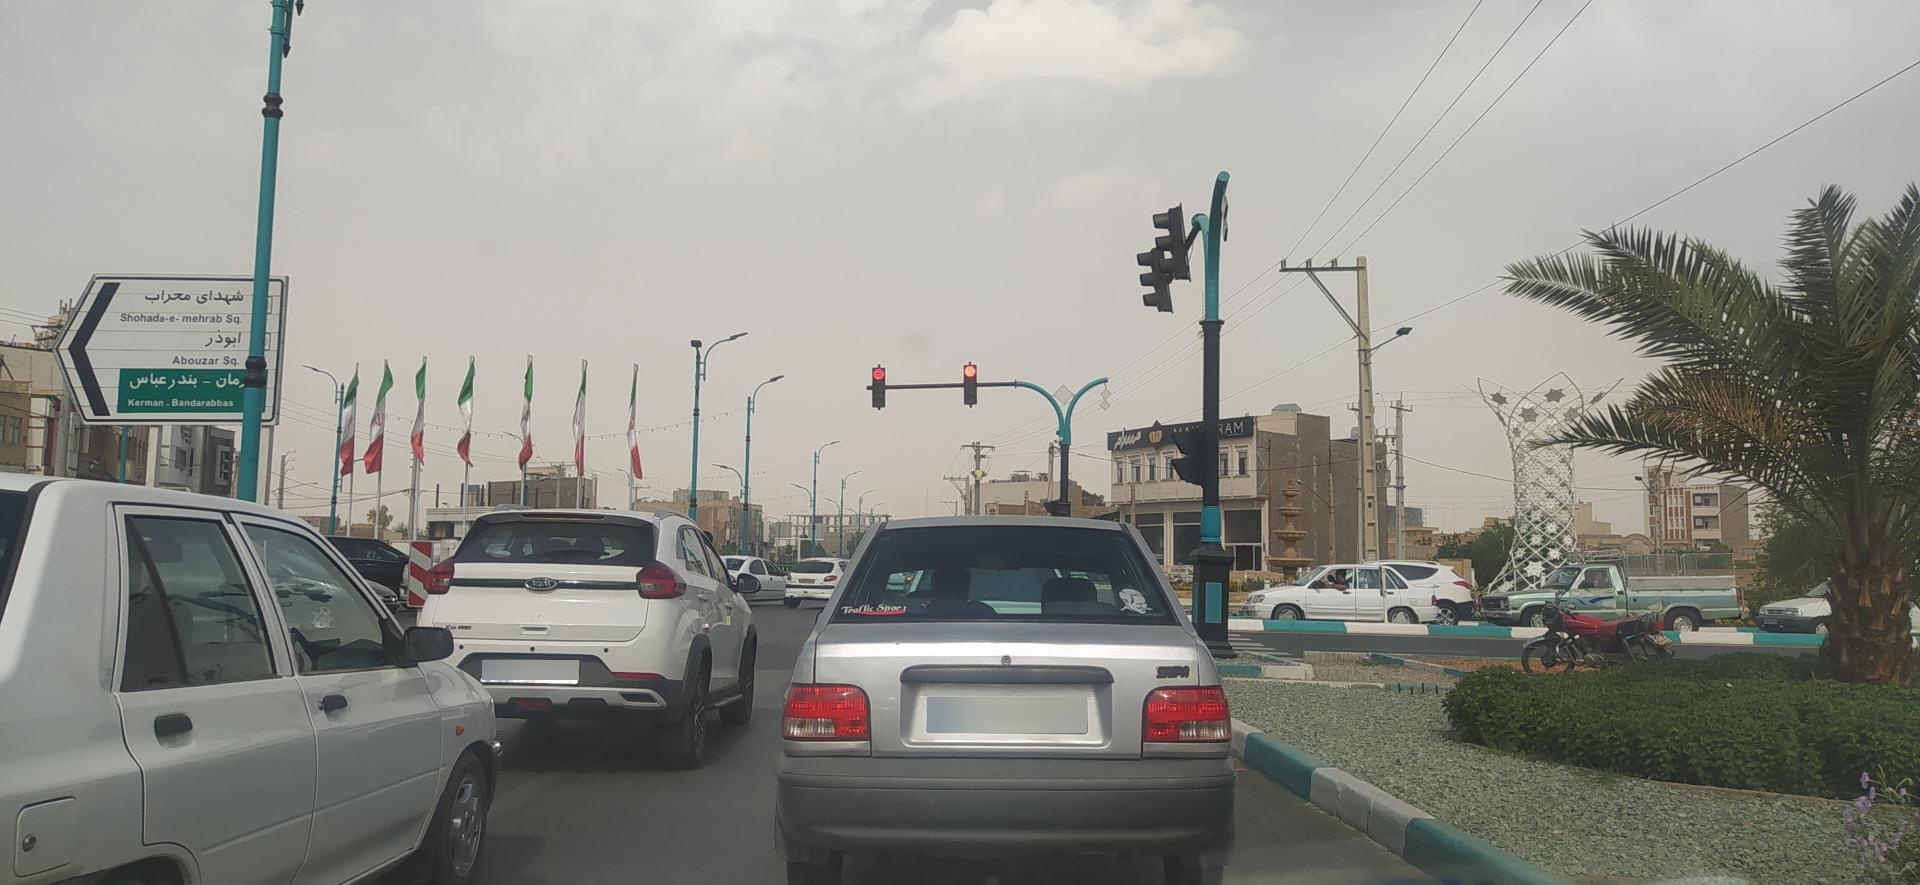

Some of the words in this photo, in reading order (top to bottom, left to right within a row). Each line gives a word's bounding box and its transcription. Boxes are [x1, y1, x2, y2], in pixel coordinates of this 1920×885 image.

[144, 289, 191, 304] محراب
[196, 289, 244, 305] شهدای
[182, 314, 222, 323] mehrab
[225, 314, 243, 325] Sq.
[204, 329, 242, 348] ابوذر
[172, 356, 220, 366] Abouzar
[222, 356, 240, 368] Sq.
[128, 398, 164, 407] Kerman
[171, 398, 234, 407] Bandarabbas
[876, 603, 907, 614] Sport
